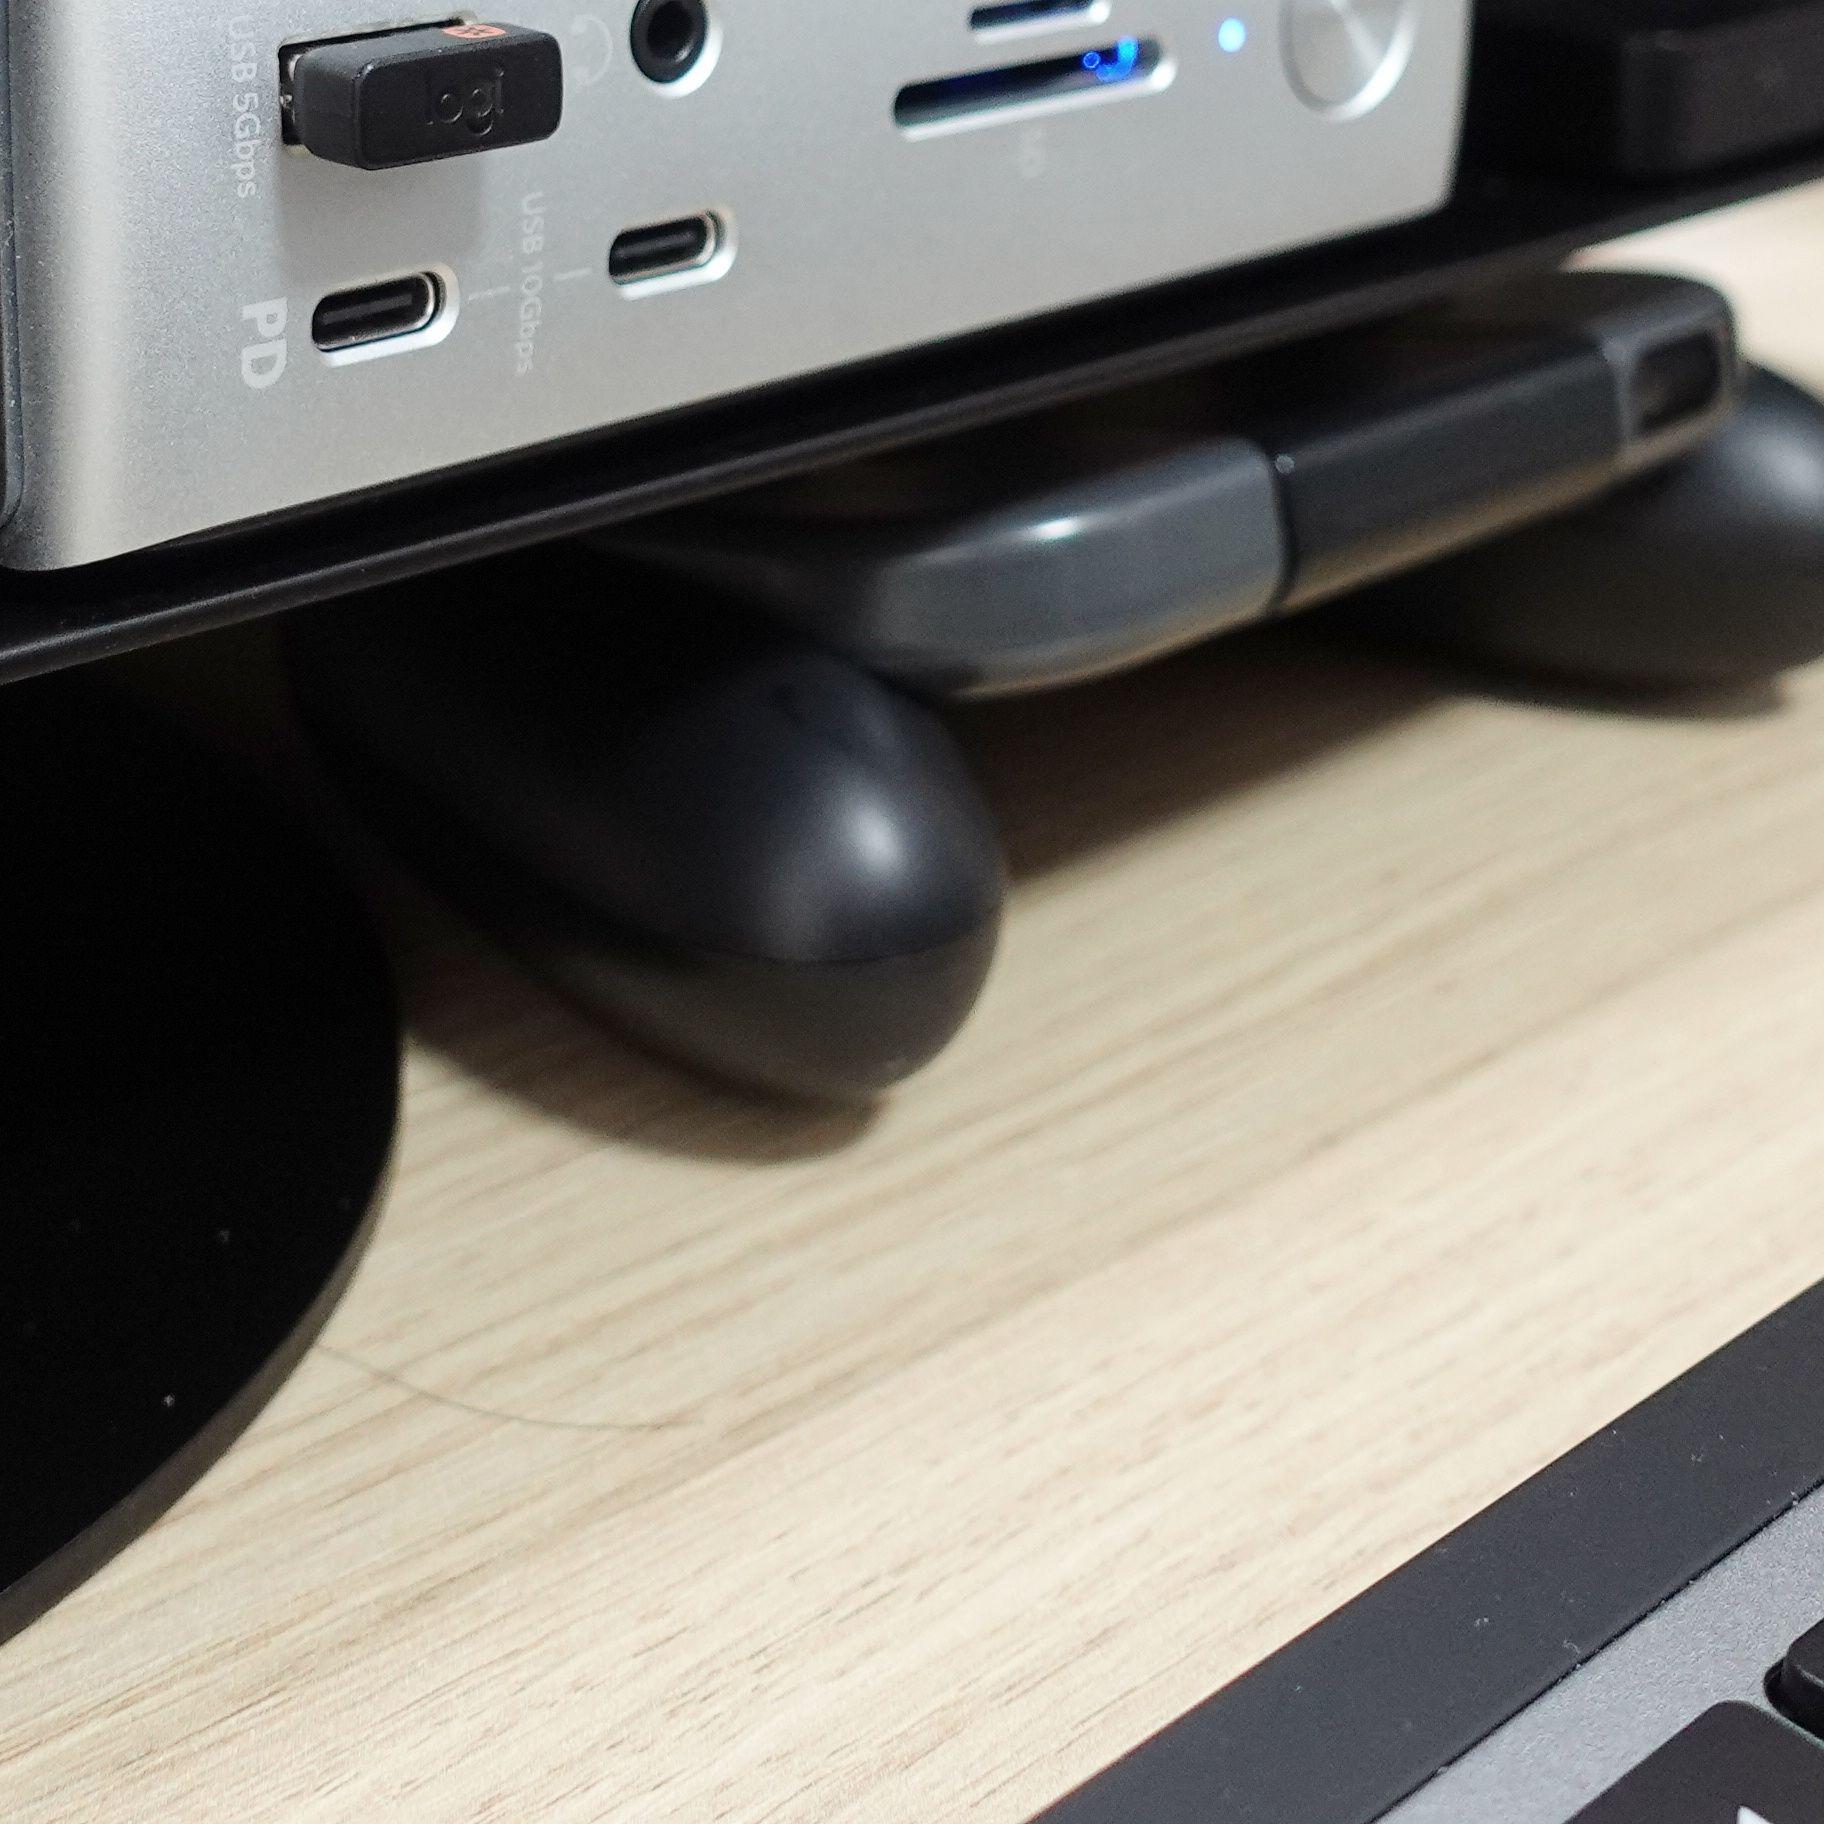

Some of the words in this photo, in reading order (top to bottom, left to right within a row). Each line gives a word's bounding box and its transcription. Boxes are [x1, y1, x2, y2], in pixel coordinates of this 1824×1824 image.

[229, 15, 258, 80] USB
[232, 91, 262, 199] 5Gbps
[521, 190, 545, 255] USB
[240, 296, 288, 390] PD
[515, 261, 544, 377] 10Gbps
